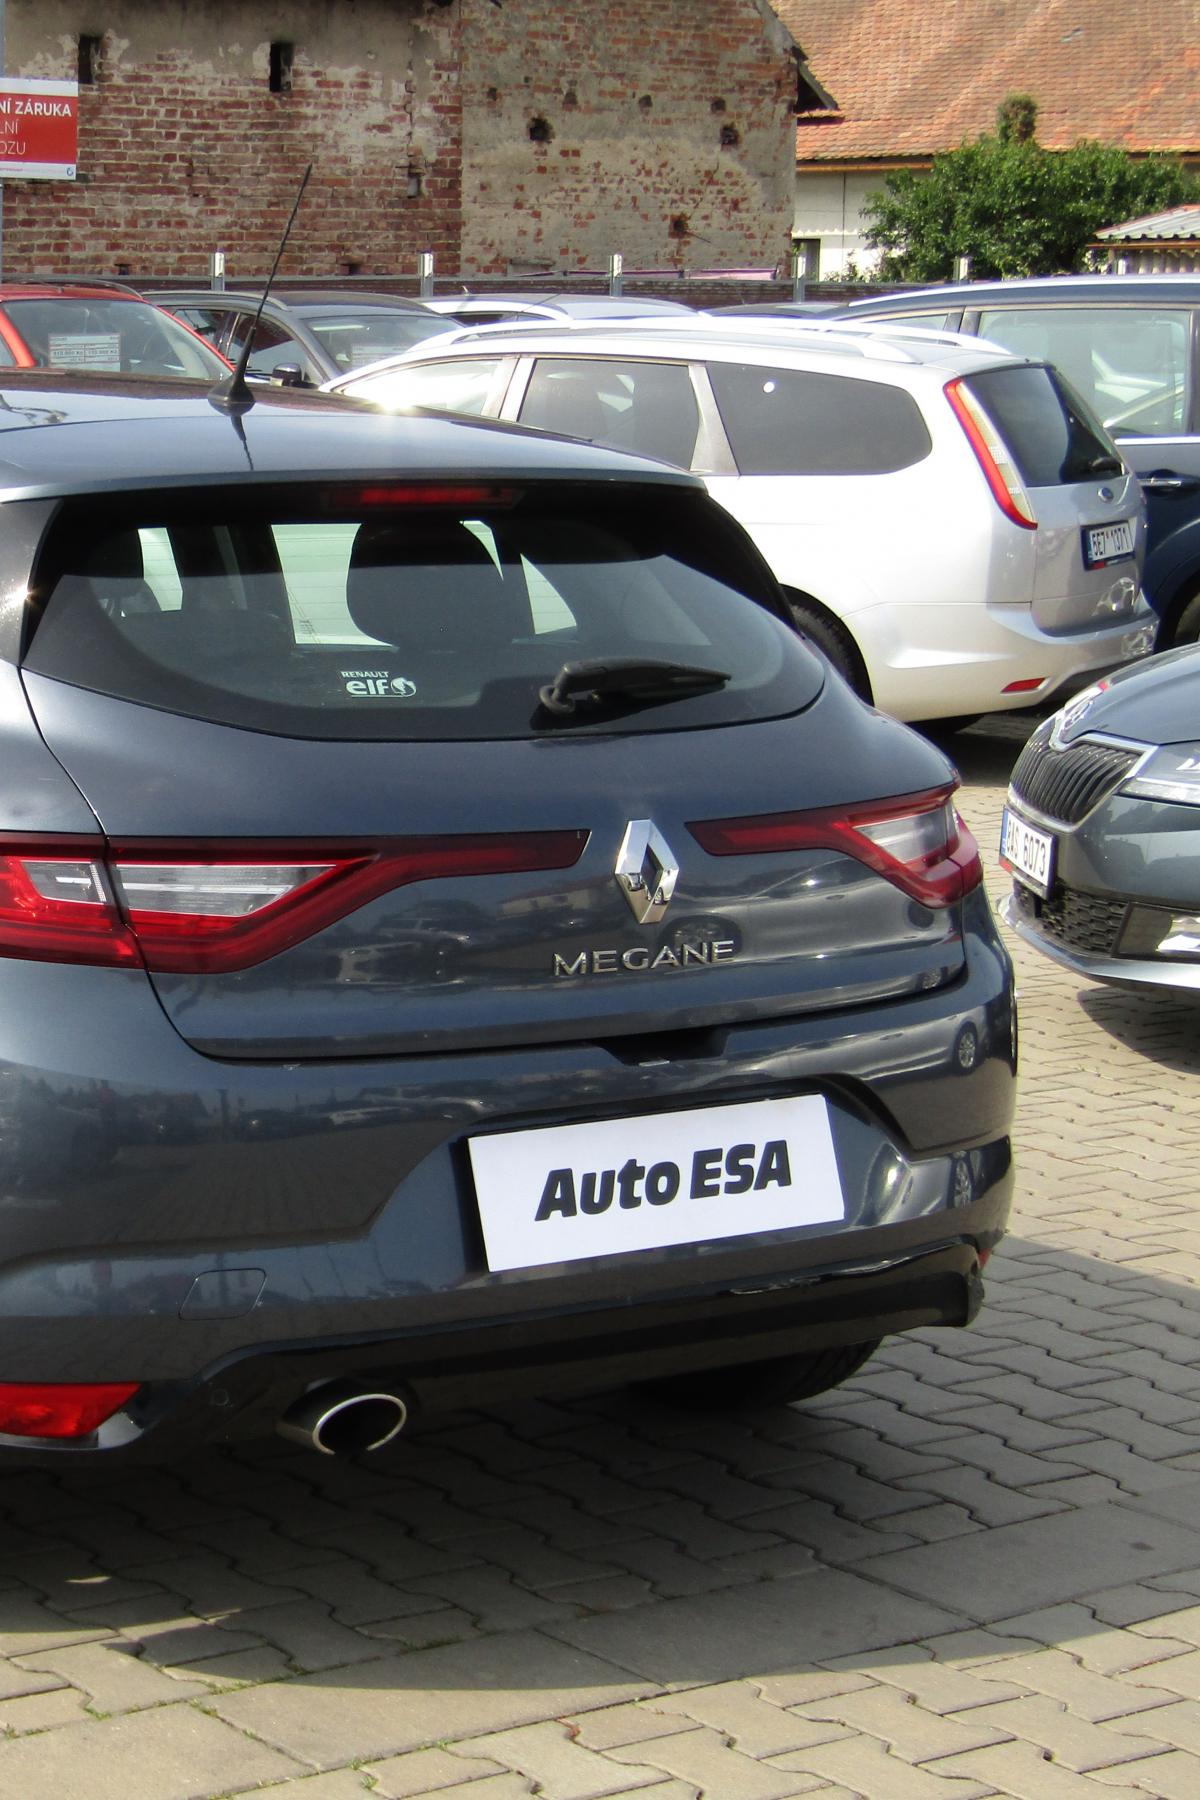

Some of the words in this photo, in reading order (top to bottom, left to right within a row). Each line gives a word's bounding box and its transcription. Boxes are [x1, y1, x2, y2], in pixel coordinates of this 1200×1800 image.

[14, 98, 72, 118] ZÁRUKA
[346, 679, 389, 695] elf
[1023, 832, 1046, 878] 6073
[553, 939, 735, 977] MEGANE
[534, 1157, 681, 1222] Auto
[689, 1139, 792, 1200] ESA
